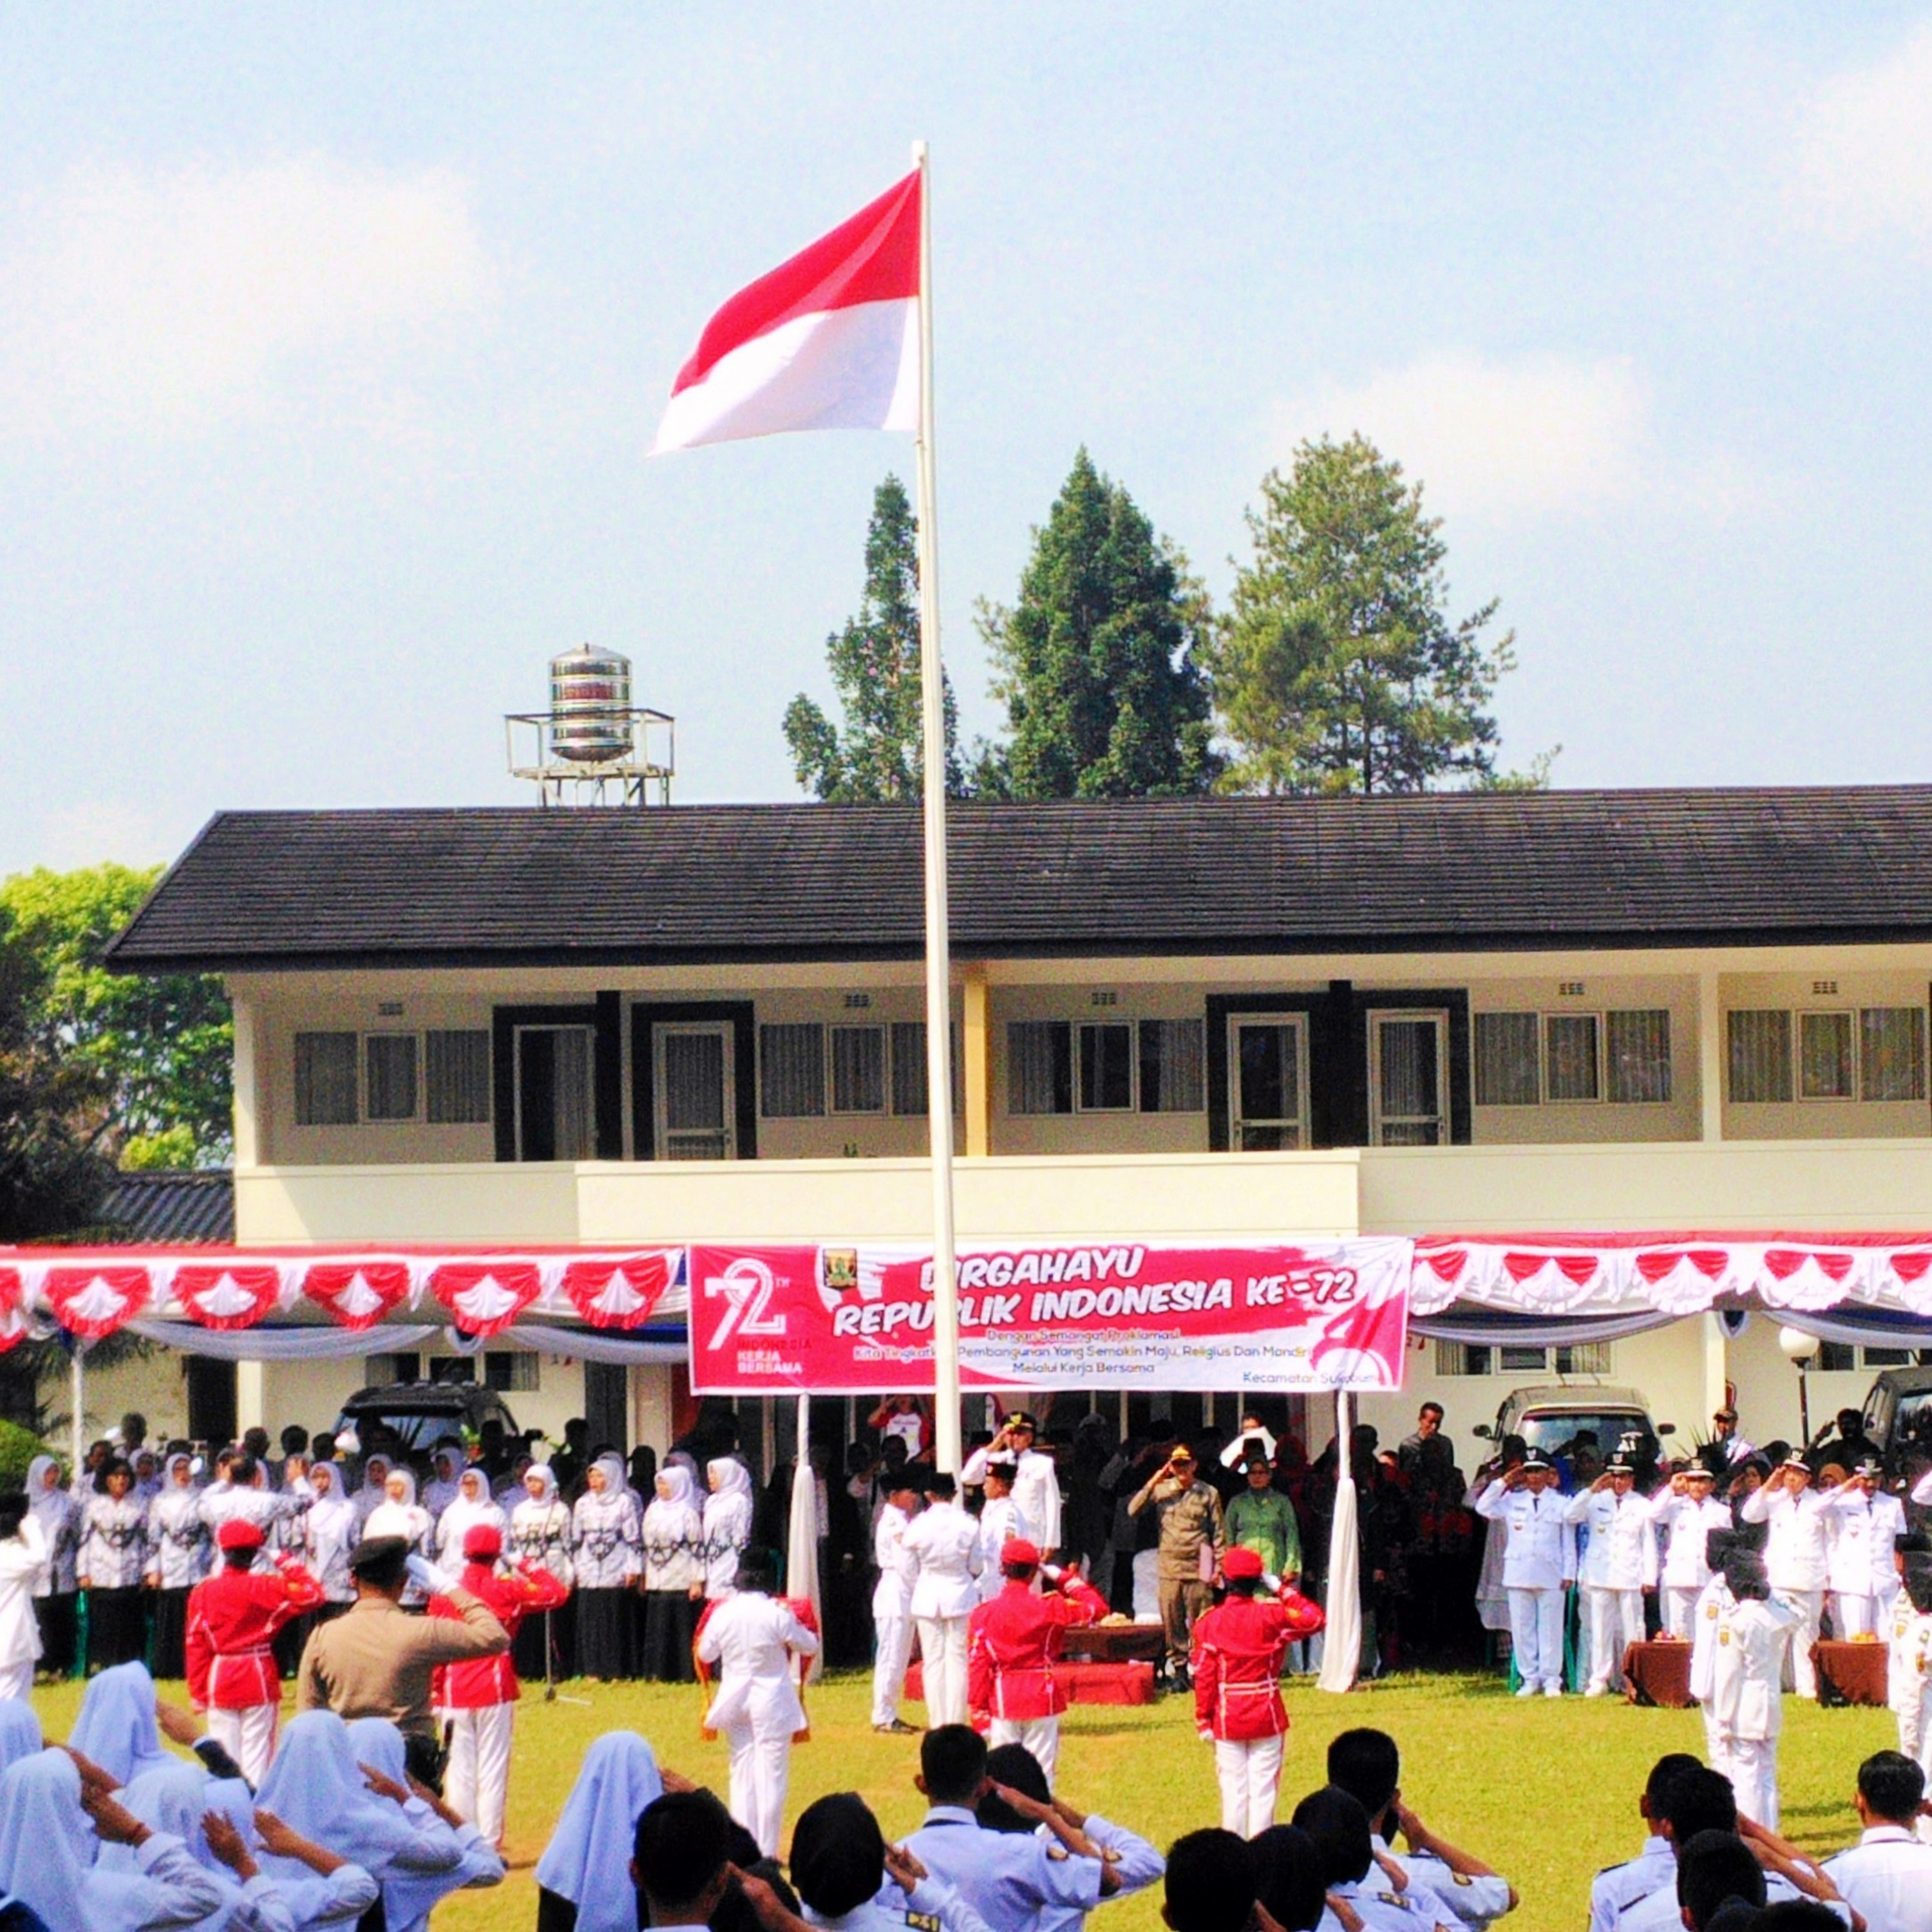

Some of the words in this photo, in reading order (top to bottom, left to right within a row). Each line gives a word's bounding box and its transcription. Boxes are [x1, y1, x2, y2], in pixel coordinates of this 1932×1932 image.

[705, 1258, 786, 1350] 72
[833, 1292, 1022, 1336] REPULIK
[1030, 1279, 1233, 1321] INDONESIA
[988, 1330, 1035, 1343] Dengan
[1040, 1329, 1104, 1343] Semangat
[737, 1351, 781, 1361] KERJA
[958, 1347, 1050, 1361] Pembangunan
[1054, 1346, 1083, 1360] Yang
[1086, 1345, 1142, 1357] Semakin
[1183, 1345, 1231, 1359] Religius
[1234, 1346, 1260, 1357] Dan
[737, 1362, 803, 1374] BERSAMA
[1012, 1362, 1057, 1373] Melalui
[1061, 1361, 1093, 1376] Kerja
[1097, 1361, 1155, 1373] Bersama
[1243, 1371, 1316, 1384] Kecamatan
